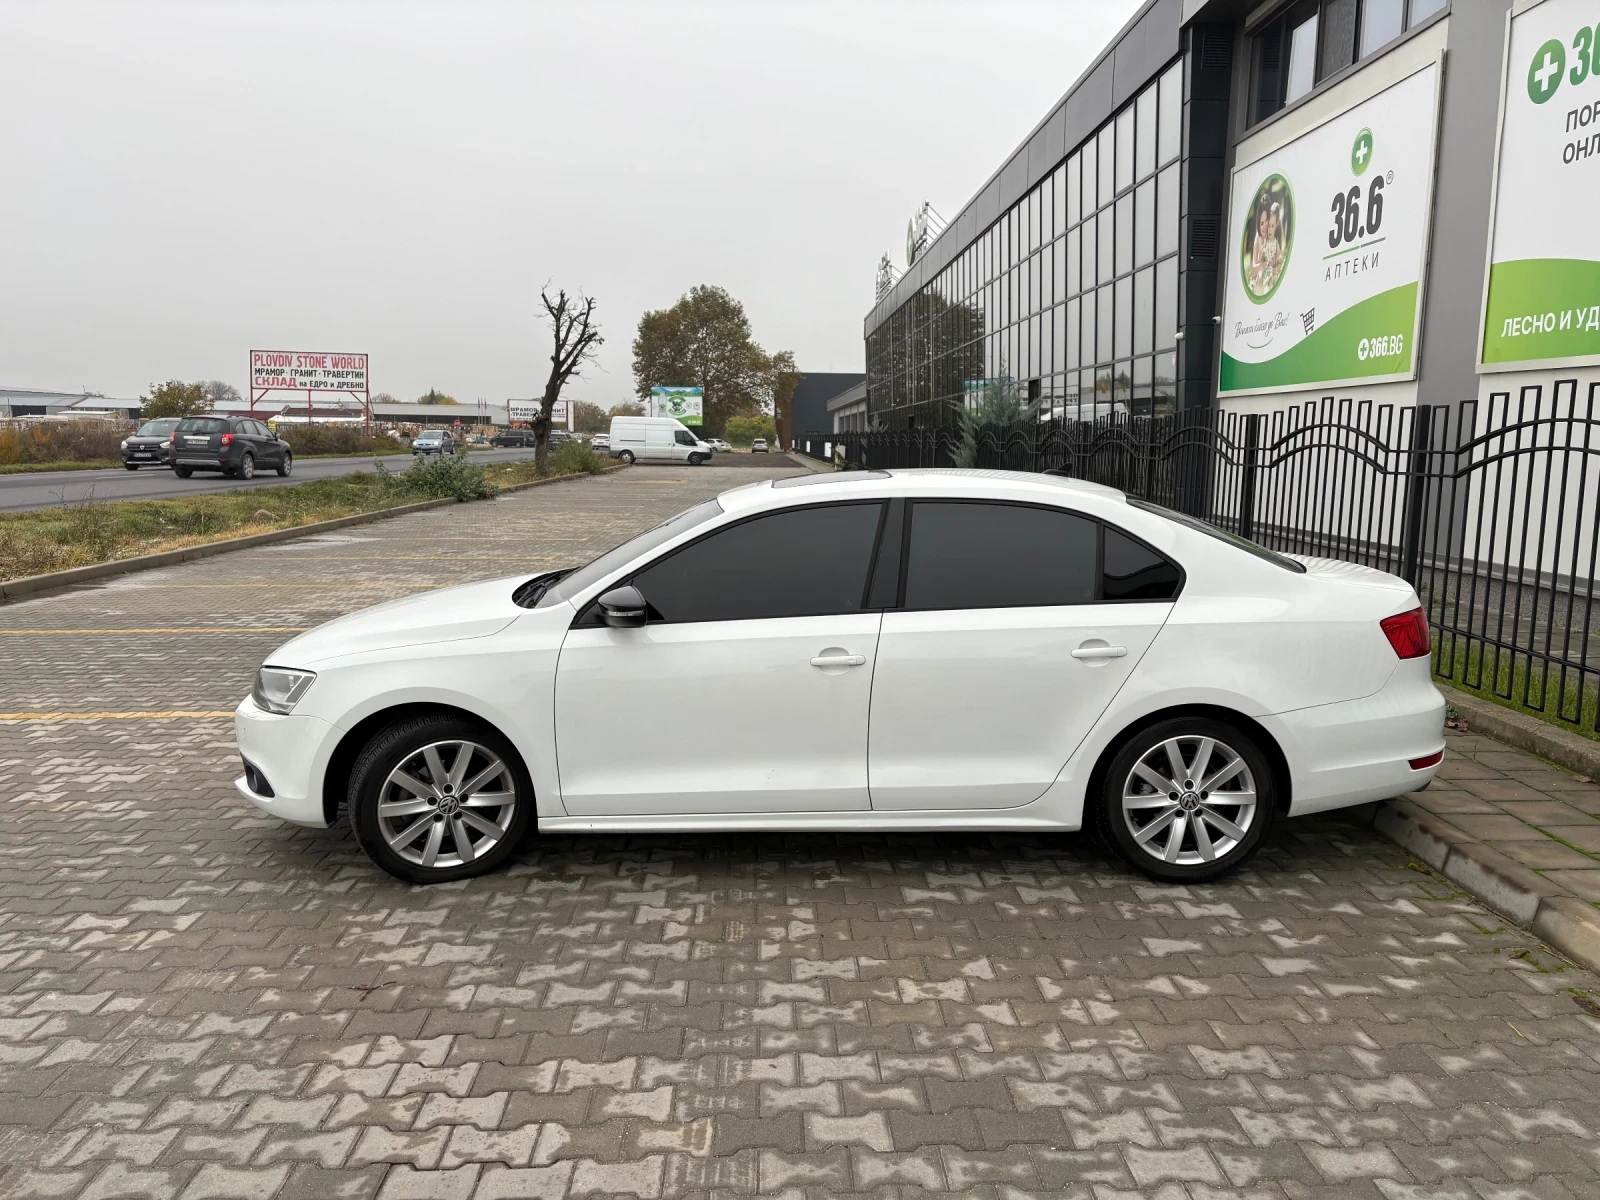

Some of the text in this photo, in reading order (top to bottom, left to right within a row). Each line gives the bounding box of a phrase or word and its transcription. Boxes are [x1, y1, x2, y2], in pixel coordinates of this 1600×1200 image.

[1325, 252, 1379, 282] АПТЕКИ
[1501, 305, 1600, 337] ЛЕСНО И УД
[1370, 334, 1403, 358] 366.BG
[253, 354, 364, 370] PLOVDIV STONE WORLD
[254, 368, 364, 379] МРАМОР ГРАНИТ ТРАВЕРТИН
[255, 376, 297, 388] СКЛАД
[310, 380, 327, 388] ЕДРО
[337, 381, 364, 389] ДРЕБНО
